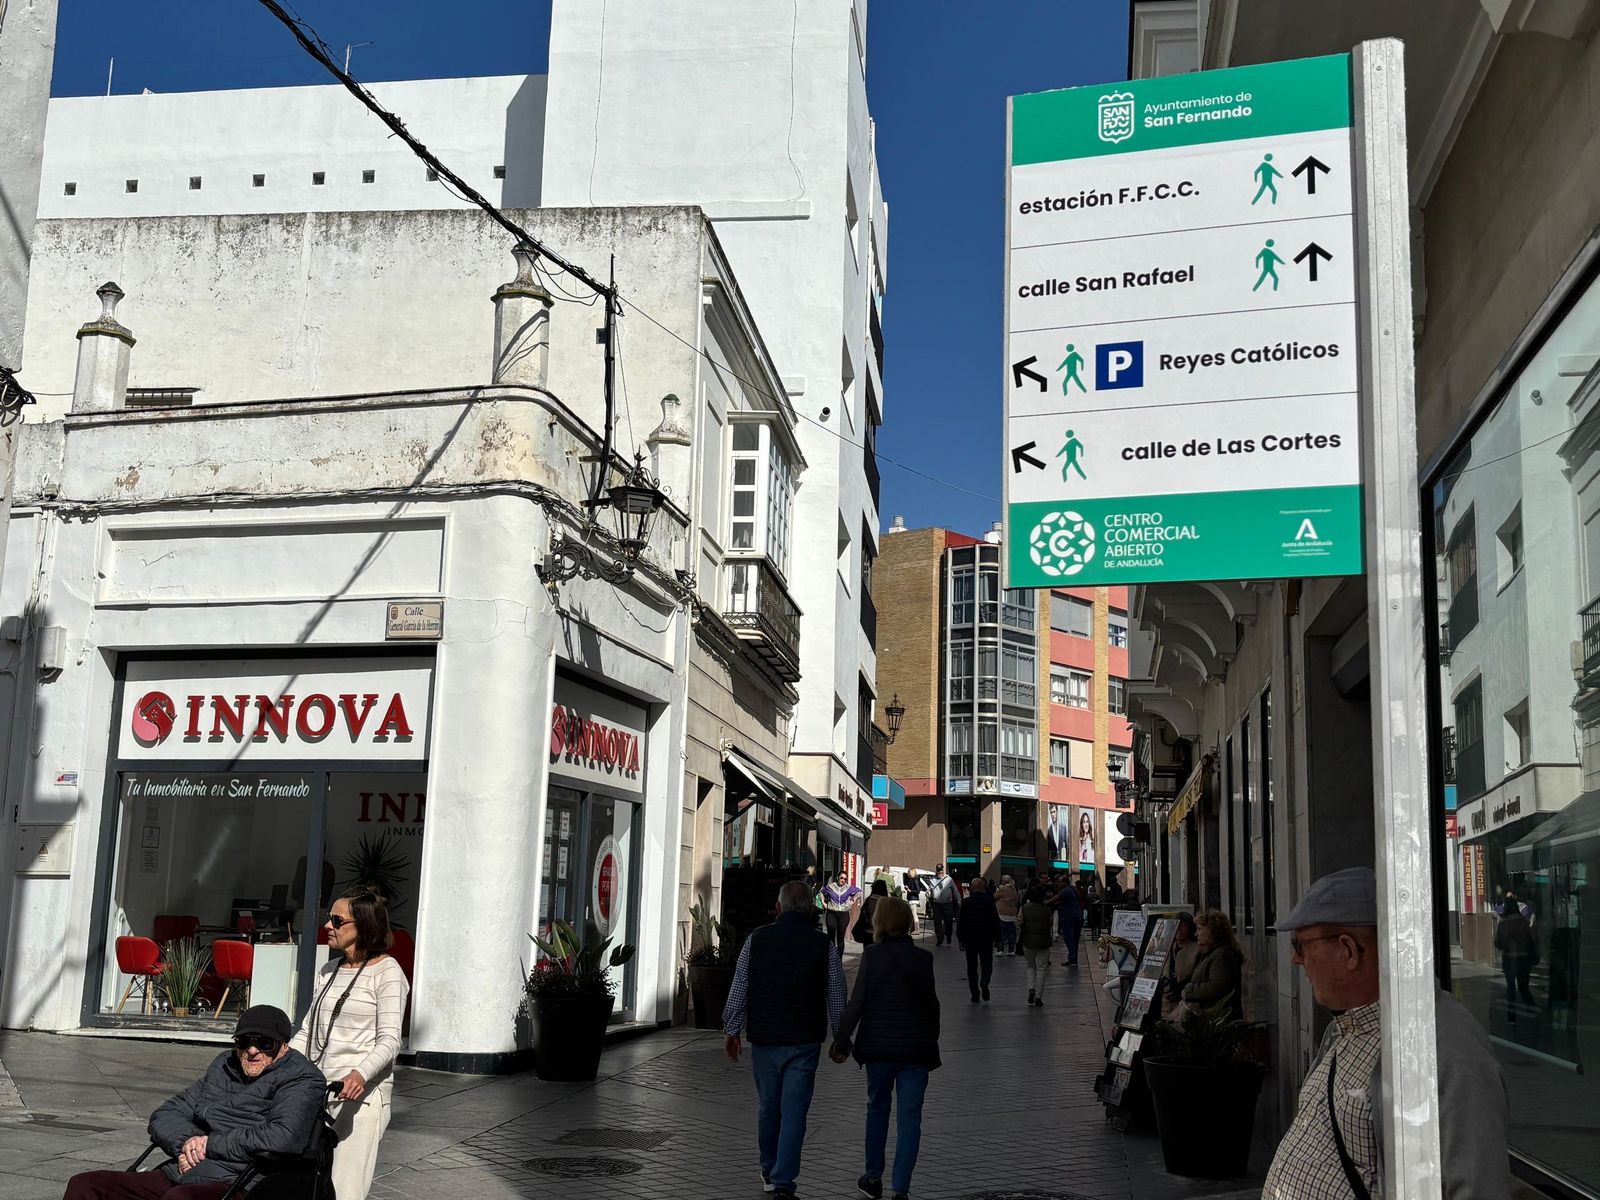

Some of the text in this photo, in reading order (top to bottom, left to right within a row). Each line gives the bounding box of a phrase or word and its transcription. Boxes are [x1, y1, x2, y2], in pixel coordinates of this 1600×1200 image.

[1103, 106, 1129, 118] SAN
[1144, 91, 1252, 113] Ayuntamiento de
[1144, 105, 1252, 128] San Fernando
[1019, 180, 1200, 215] estación F.F.C.C.
[1018, 265, 1194, 299] calle San Rafael
[1108, 350, 1133, 383] P
[1159, 342, 1339, 374] Reyes Católicos
[1121, 432, 1341, 461] calle de Las Cortes
[1104, 512, 1163, 527] CENTRO
[1104, 524, 1200, 543] COMERCIAL
[1104, 543, 1164, 557] ABIERTO
[1104, 557, 1164, 568] DE ANDALUCÍA
[405, 607, 424, 616] Calle
[183, 692, 414, 738] INNOVA
[568, 715, 640, 772] INNOVA
[127, 778, 310, 798] Tu Inmobiliaria en San Fernando
